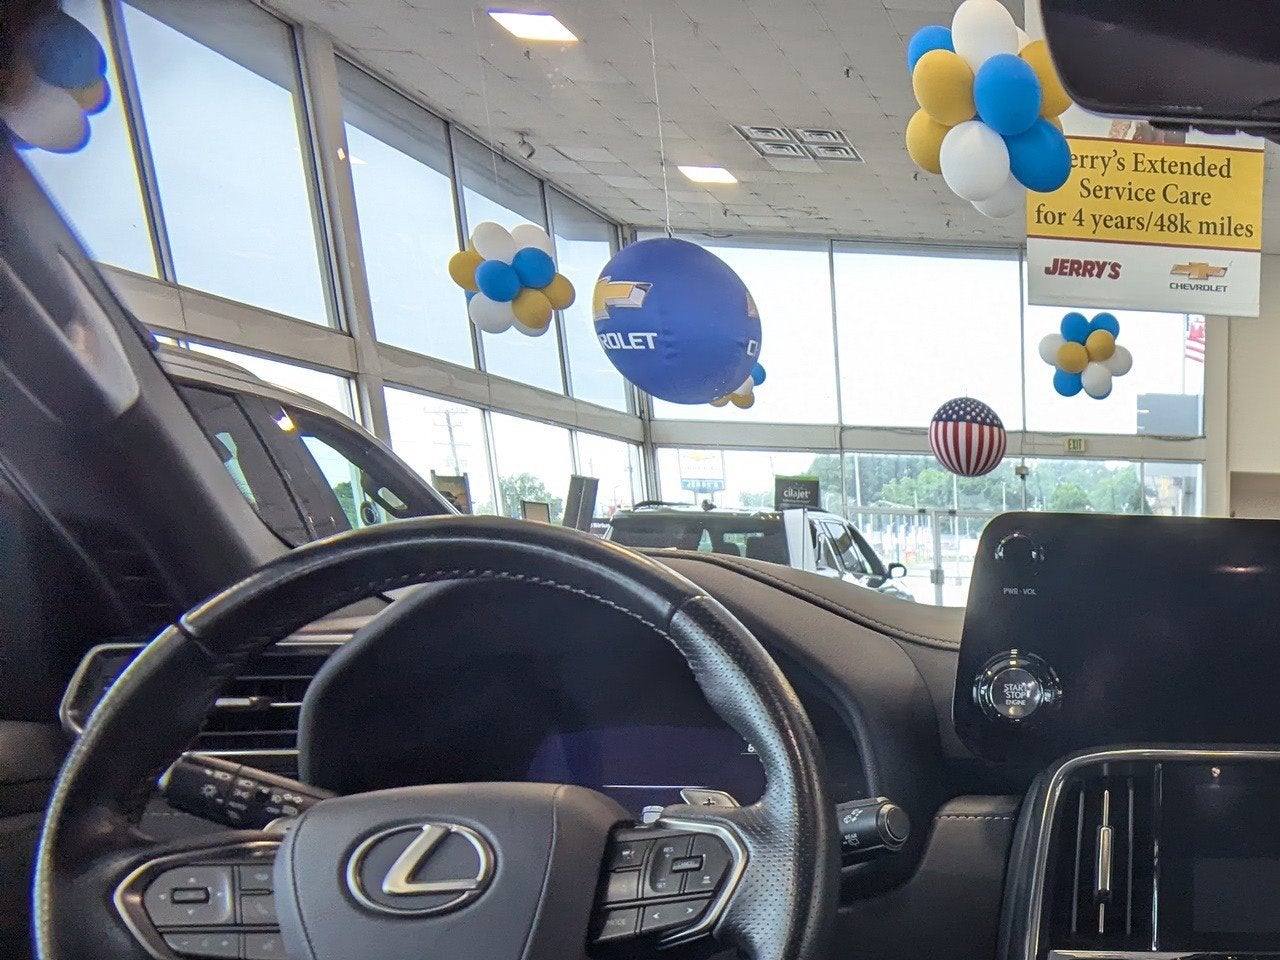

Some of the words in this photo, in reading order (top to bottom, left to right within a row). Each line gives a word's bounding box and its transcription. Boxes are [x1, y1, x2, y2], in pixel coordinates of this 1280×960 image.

[1070, 149, 1125, 177] erry's
[1132, 152, 1232, 178] Extended
[1079, 178, 1156, 203] Service
[1162, 183, 1212, 206] Care
[1035, 203, 1067, 225] for
[1072, 207, 1085, 227] 4
[1090, 211, 1192, 235] years/48k
[1198, 214, 1254, 238] miles
[1044, 257, 1122, 280] JERRY'S
[1169, 282, 1228, 293] CHEVROLET
[1068, 438, 1083, 450] EXIT
[1005, 691, 1026, 699] STOP
